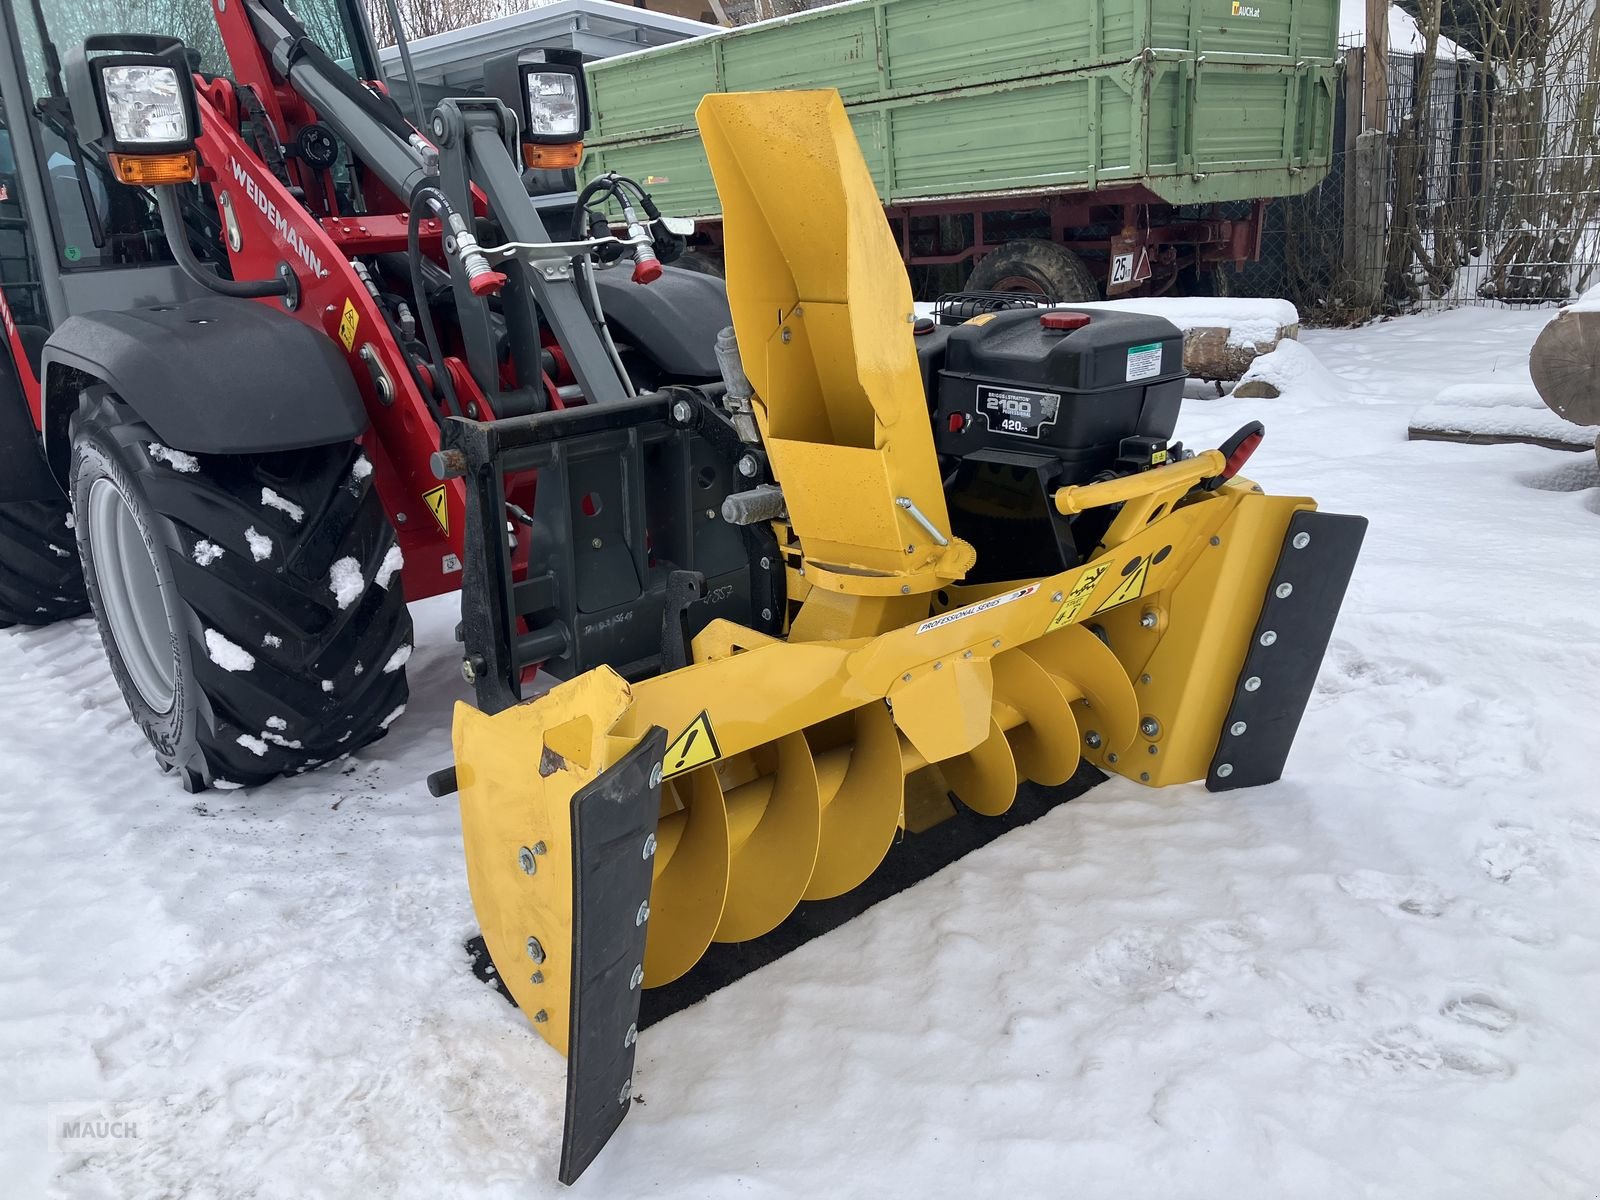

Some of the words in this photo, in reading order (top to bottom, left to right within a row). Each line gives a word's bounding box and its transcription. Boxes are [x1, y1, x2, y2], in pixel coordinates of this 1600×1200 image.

[231, 155, 322, 279] WEIDEMANN
[1113, 257, 1127, 282] 25
[986, 397, 1032, 413] 2100
[920, 607, 976, 632] PROFESSIONAL
[976, 599, 1001, 613] SERIES
